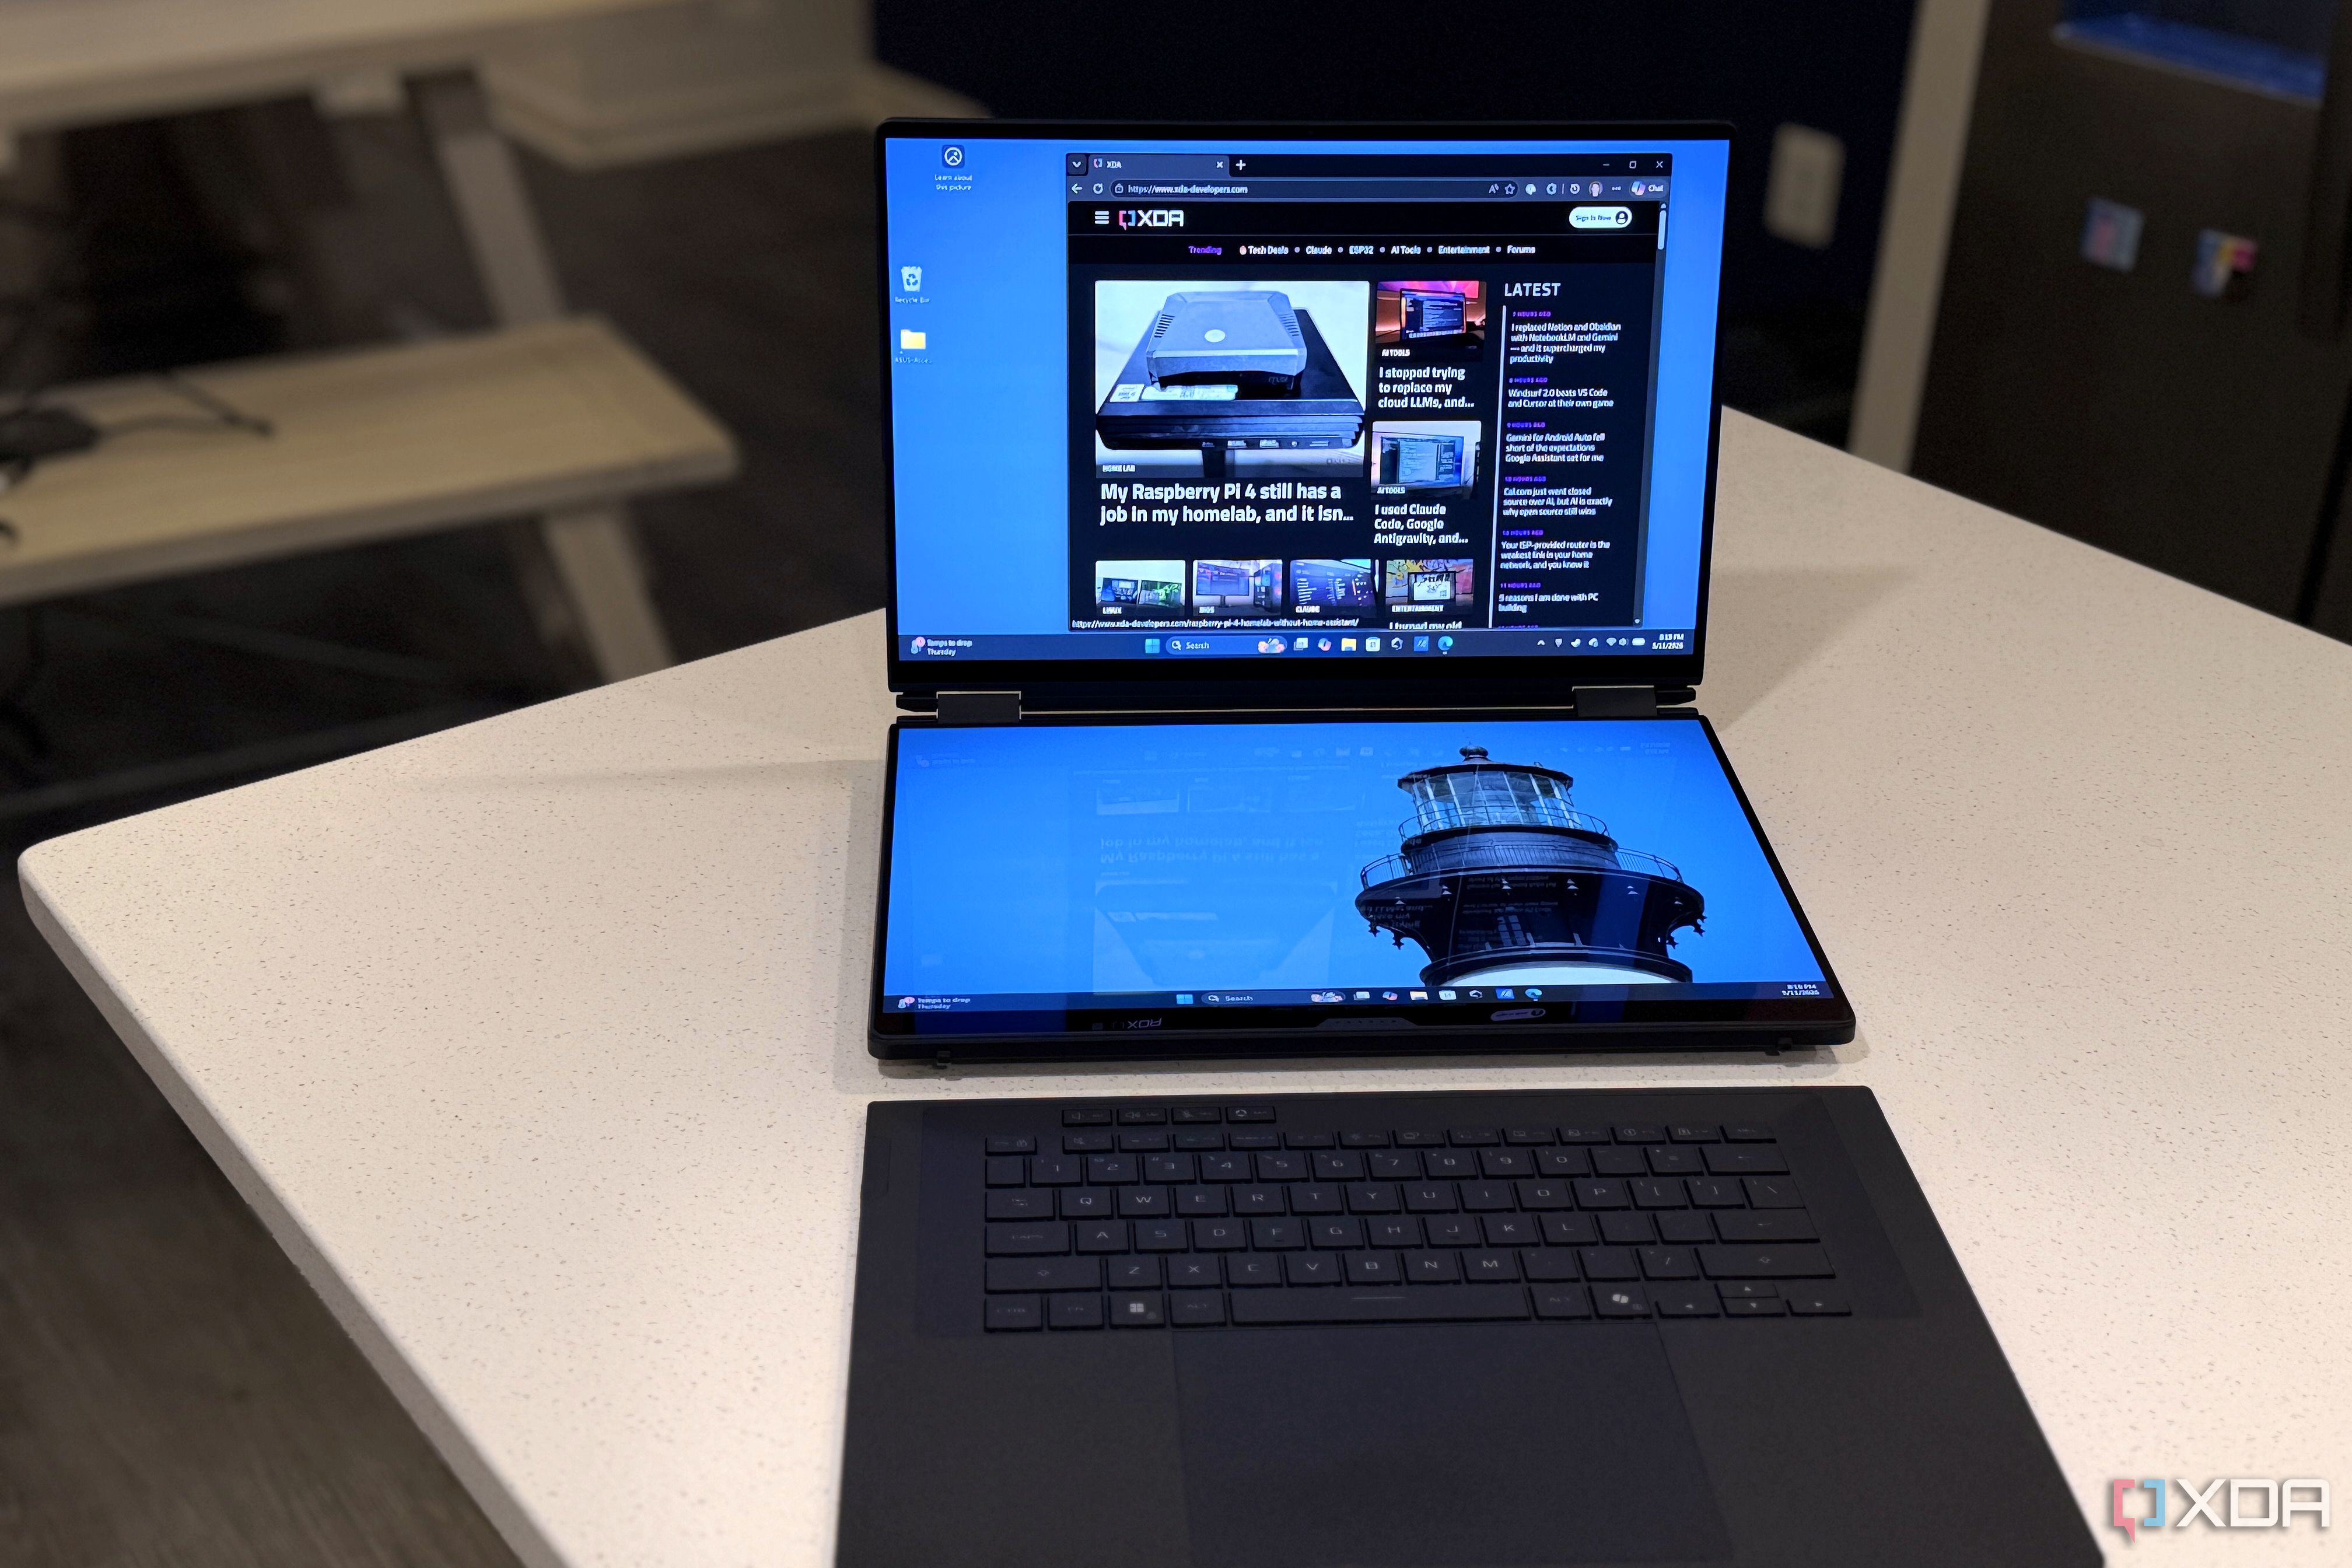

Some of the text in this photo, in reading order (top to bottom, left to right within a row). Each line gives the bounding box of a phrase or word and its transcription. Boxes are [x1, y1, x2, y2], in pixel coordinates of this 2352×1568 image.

[1128, 184, 1248, 195] https://www.xda-developers.com
[1138, 210, 1184, 226] XDA
[1189, 246, 1535, 254] Trending Tech Deals Claude ESP32 AI Tools Entertainment Forums
[1504, 282, 1561, 296] LATEST
[1516, 323, 1546, 332] replaced
[1543, 344, 1592, 353] supercharged
[1594, 345, 1605, 353] my
[1510, 355, 1553, 364] productivity
[1380, 367, 1465, 380] I stopped trying
[1378, 382, 1452, 395] to replace my
[1378, 397, 1475, 409] cloud LLMs, and...
[1506, 433, 1532, 442] Gemini
[1533, 433, 1544, 442] for
[1545, 433, 1573, 442] Android
[1574, 433, 1592, 442] Auto
[1549, 444, 1595, 453] expectations
[1505, 454, 1531, 464] Google
[1532, 454, 1565, 462] Assistant
[1580, 454, 1590, 462] for
[1101, 483, 1341, 503] My Raspberry Pi 4 still has a
[1532, 488, 1546, 496] just
[1568, 487, 1592, 495] closed
[1546, 498, 1555, 506] AI,
[1557, 498, 1569, 506] but
[1587, 498, 1613, 507] exactly
[1375, 503, 1447, 514] I used Claude
[1503, 508, 1518, 517] why
[1100, 505, 1354, 526] job in my homelab, and it isn...
[1374, 518, 1444, 531] Code, Google
[1374, 533, 1468, 546] Antigravity, and...
[1519, 541, 1566, 550] ISP-provided
[1555, 552, 1571, 561] your
[1500, 561, 1532, 569] network,
[1588, 593, 1598, 601] PC
[1498, 604, 1527, 613] building
[1446, 621, 1462, 629] old
[927, 648, 956, 656] Thursday
[1080, 1197, 1091, 1205] Q
